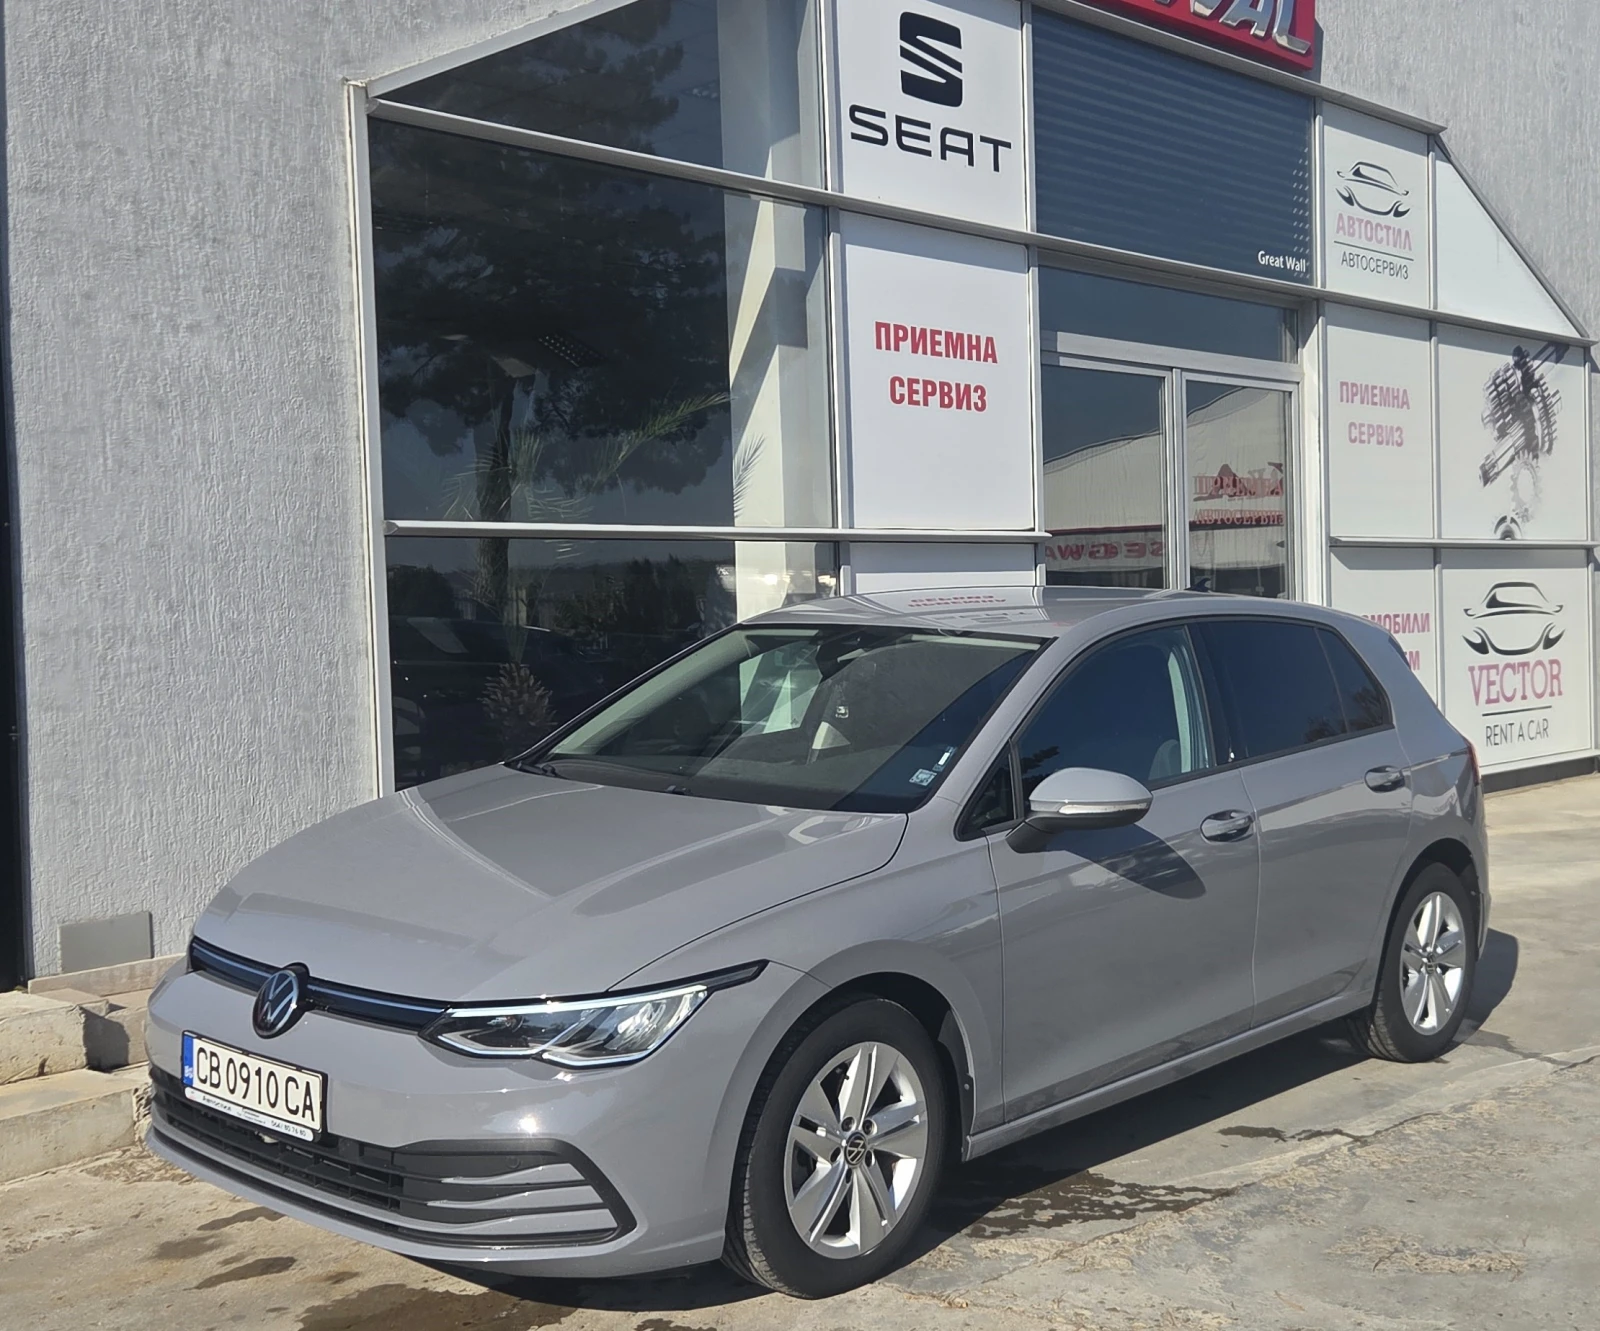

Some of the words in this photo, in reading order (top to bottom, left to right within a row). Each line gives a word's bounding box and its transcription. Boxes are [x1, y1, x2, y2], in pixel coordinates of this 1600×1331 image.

[849, 104, 1012, 173] SEAT
[1336, 213, 1412, 251] АВТОСТИЛ
[1257, 250, 1284, 268] Great
[1285, 255, 1306, 273] Wall
[1341, 251, 1409, 280] АВТОСЕРВИЗ
[874, 321, 998, 364] ПРИЕМНА
[889, 375, 988, 413] СЕРВИЗ
[1339, 381, 1411, 410] ПРИЕМНА
[1348, 421, 1404, 448] СЕРВИЗ
[1361, 613, 1431, 634] ОБИЛИ
[1468, 659, 1563, 706] VECTOR
[1485, 722, 1515, 747] RENT
[1517, 721, 1526, 742] A
[1527, 718, 1549, 741] CAR
